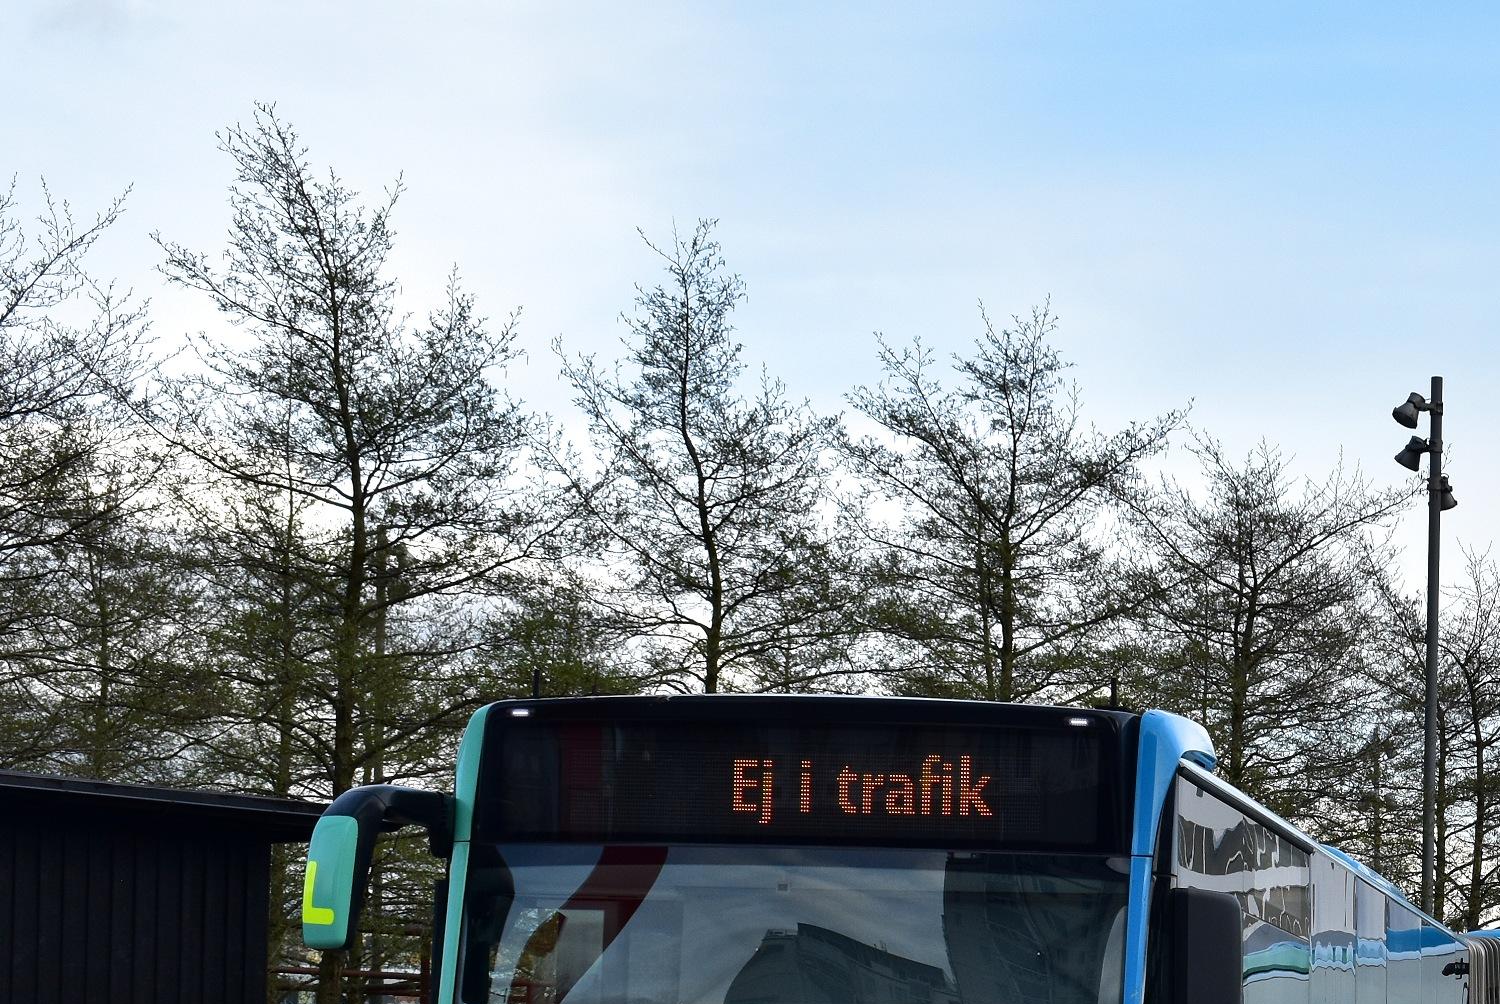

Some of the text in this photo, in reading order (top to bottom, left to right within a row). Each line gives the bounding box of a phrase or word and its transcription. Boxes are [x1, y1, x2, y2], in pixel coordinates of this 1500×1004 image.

[732, 754, 993, 824] Ej i trafik
